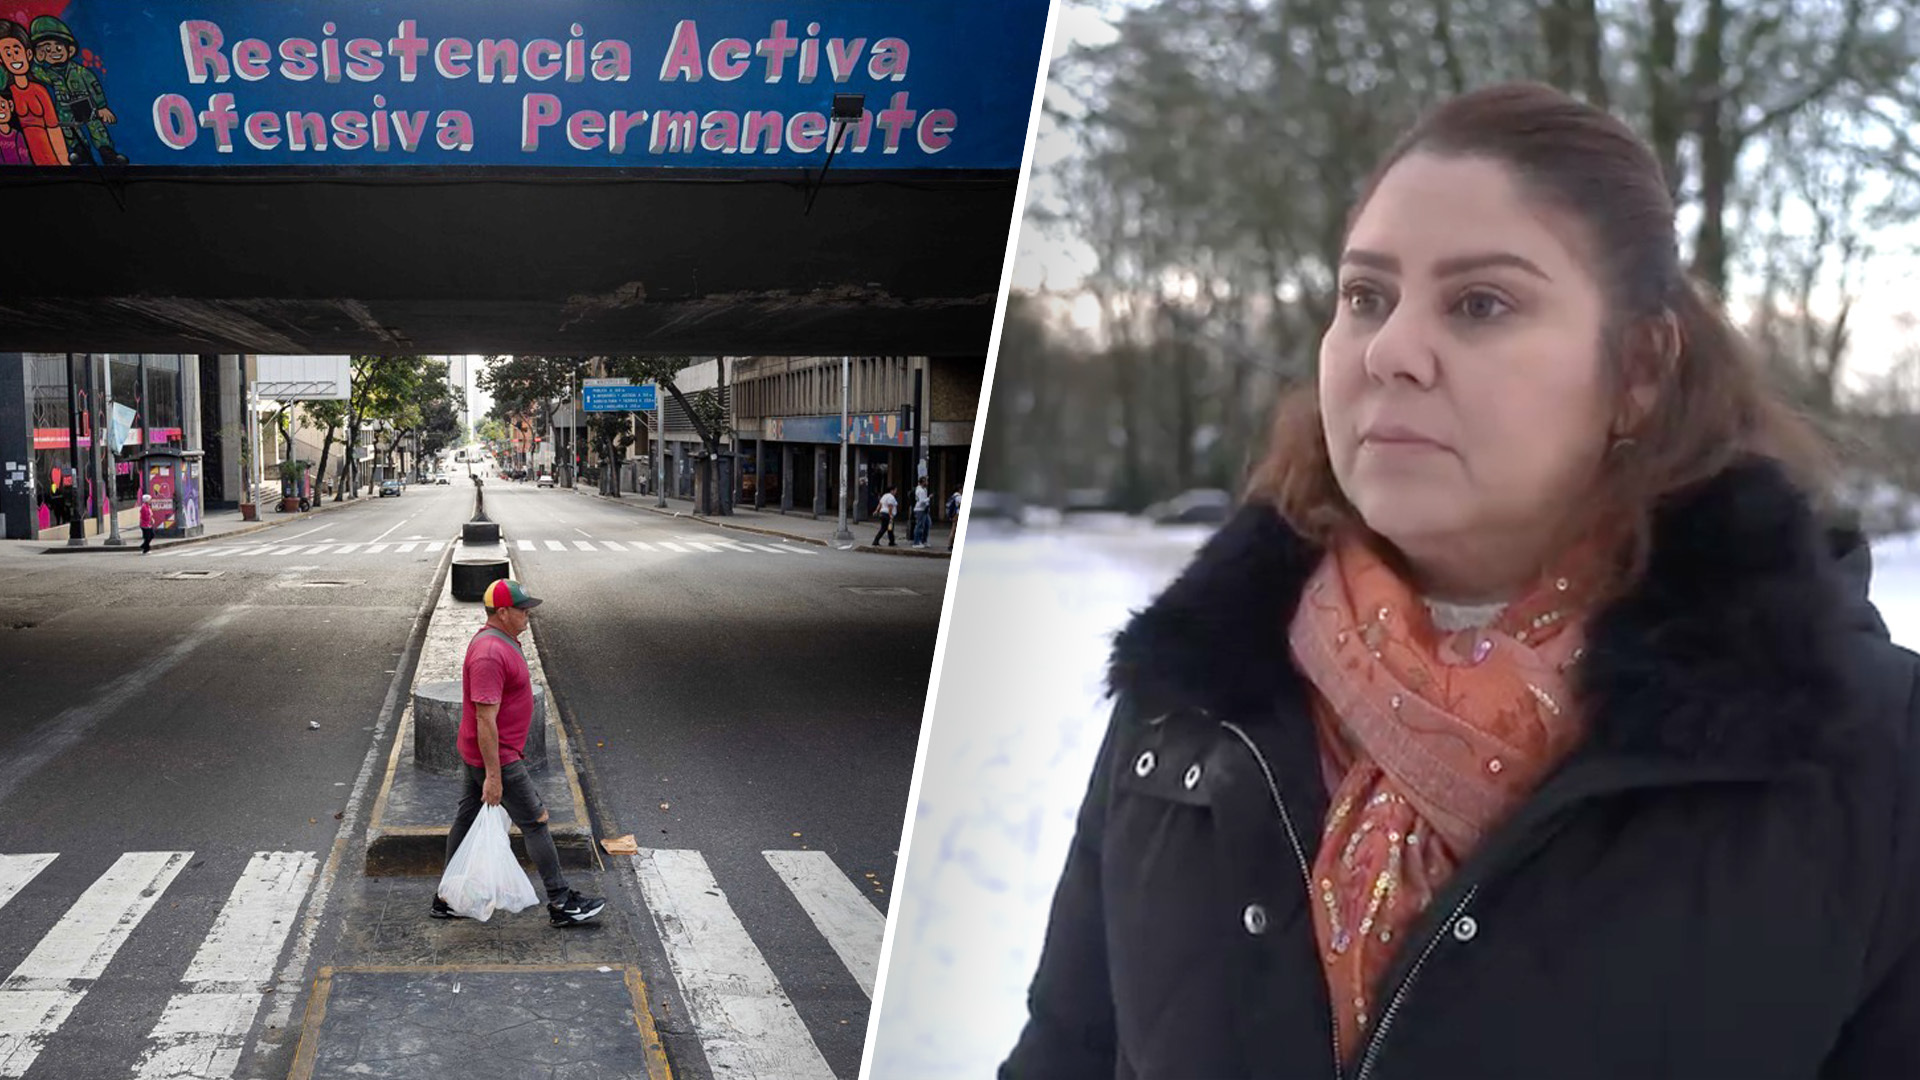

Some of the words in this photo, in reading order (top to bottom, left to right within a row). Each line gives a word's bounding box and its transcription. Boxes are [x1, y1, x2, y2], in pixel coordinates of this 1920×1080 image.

[180, 19, 631, 84] Resistencia
[659, 19, 910, 84] Activa
[152, 92, 474, 153] Ofensiva
[521, 90, 958, 154] Permanente
